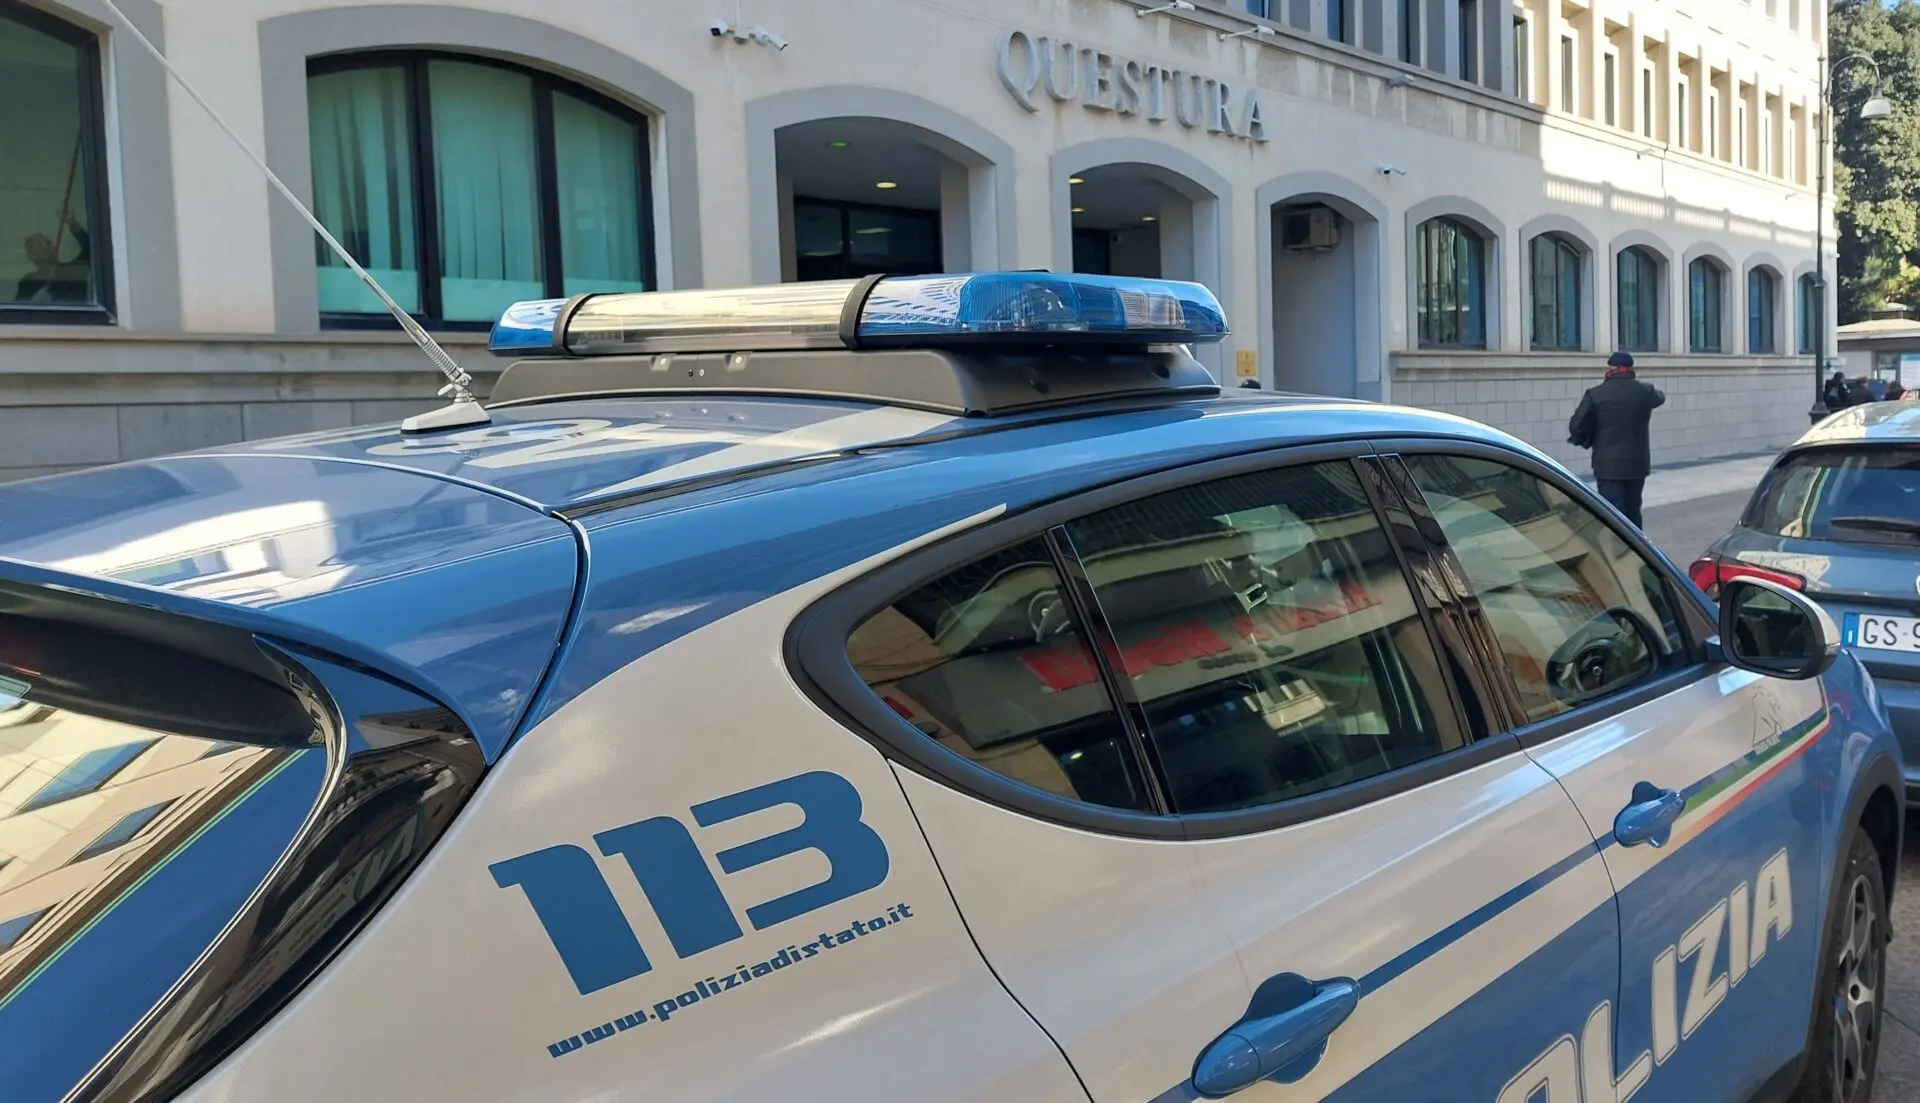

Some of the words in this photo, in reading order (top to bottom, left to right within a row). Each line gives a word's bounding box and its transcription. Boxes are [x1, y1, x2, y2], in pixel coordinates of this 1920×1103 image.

[996, 30, 1271, 143] QUESTURA
[488, 770, 890, 996] 113
[546, 902, 914, 1059] www.poliziadistato.it
